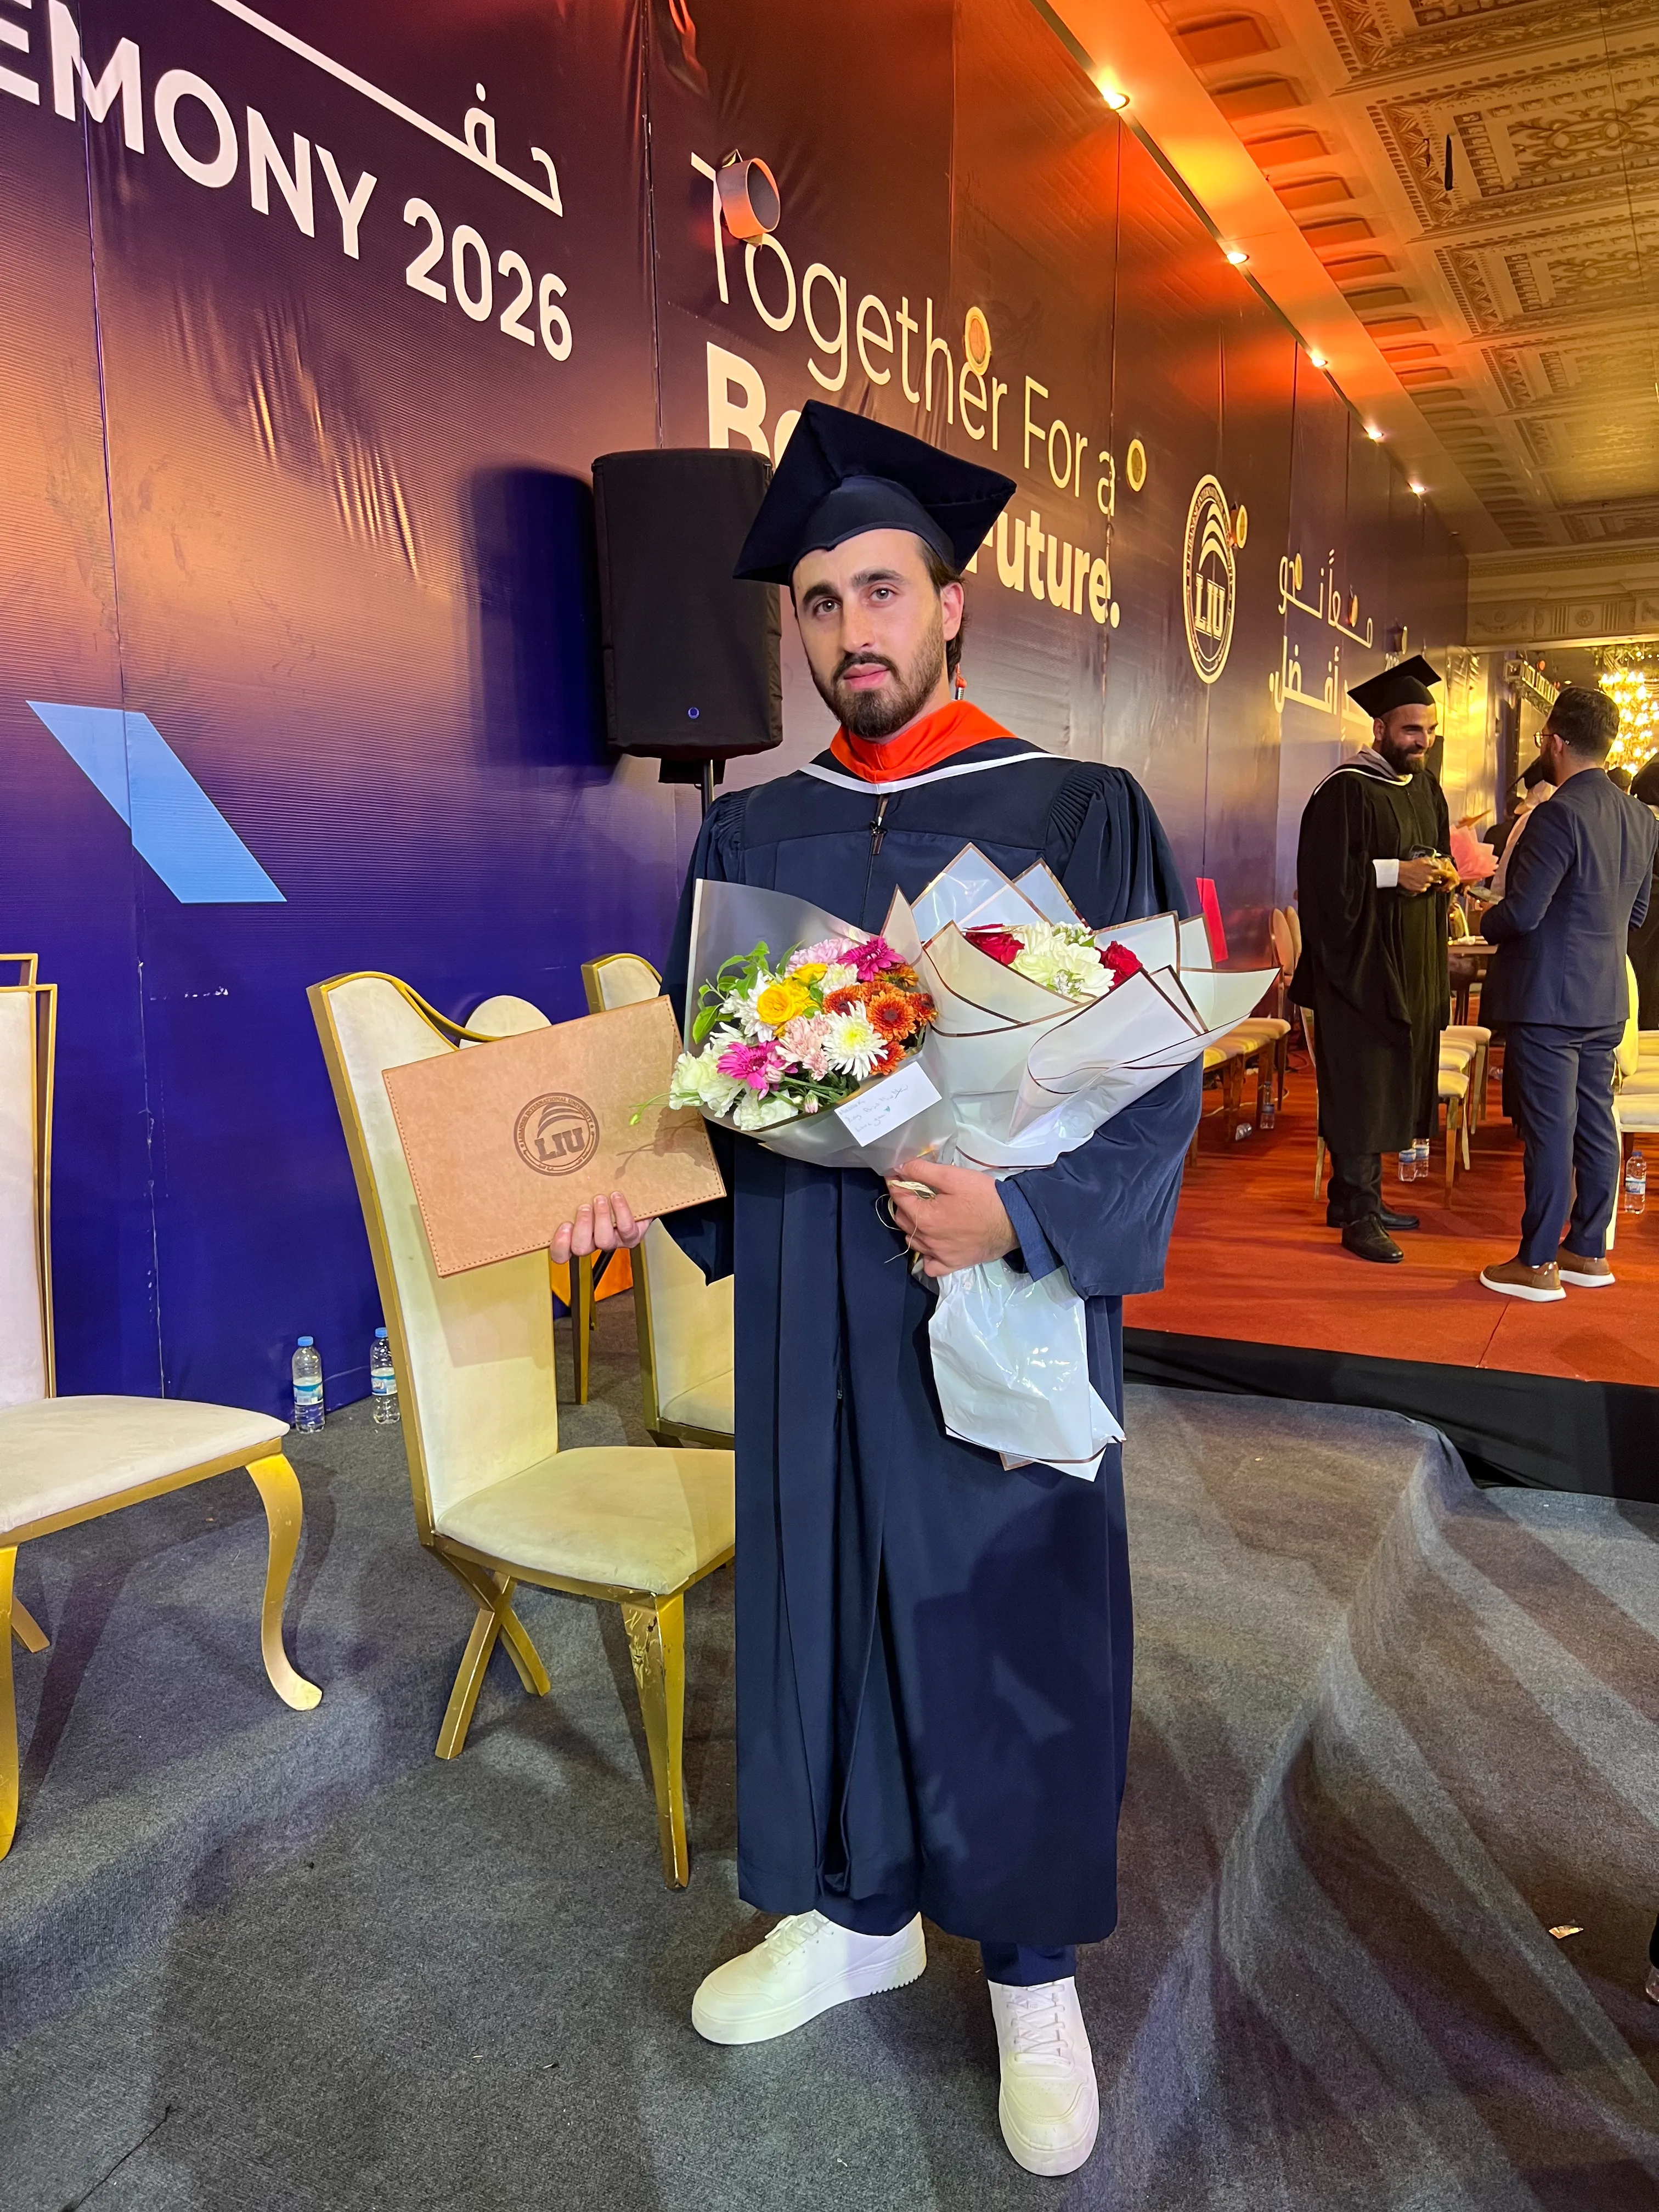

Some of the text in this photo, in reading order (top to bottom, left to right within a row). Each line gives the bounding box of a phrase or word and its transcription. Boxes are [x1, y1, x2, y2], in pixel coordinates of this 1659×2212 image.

[404, 198, 572, 362] 2026
[691, 151, 1007, 452] Together
[1024, 375, 1088, 497] For
[1097, 450, 1115, 517] a
[1195, 572, 1226, 641] LIU
[526, 1097, 567, 1117] INTERNATIONAL
[568, 1099, 593, 1123] UNIVERSITY
[534, 1127, 585, 1162] LIU
